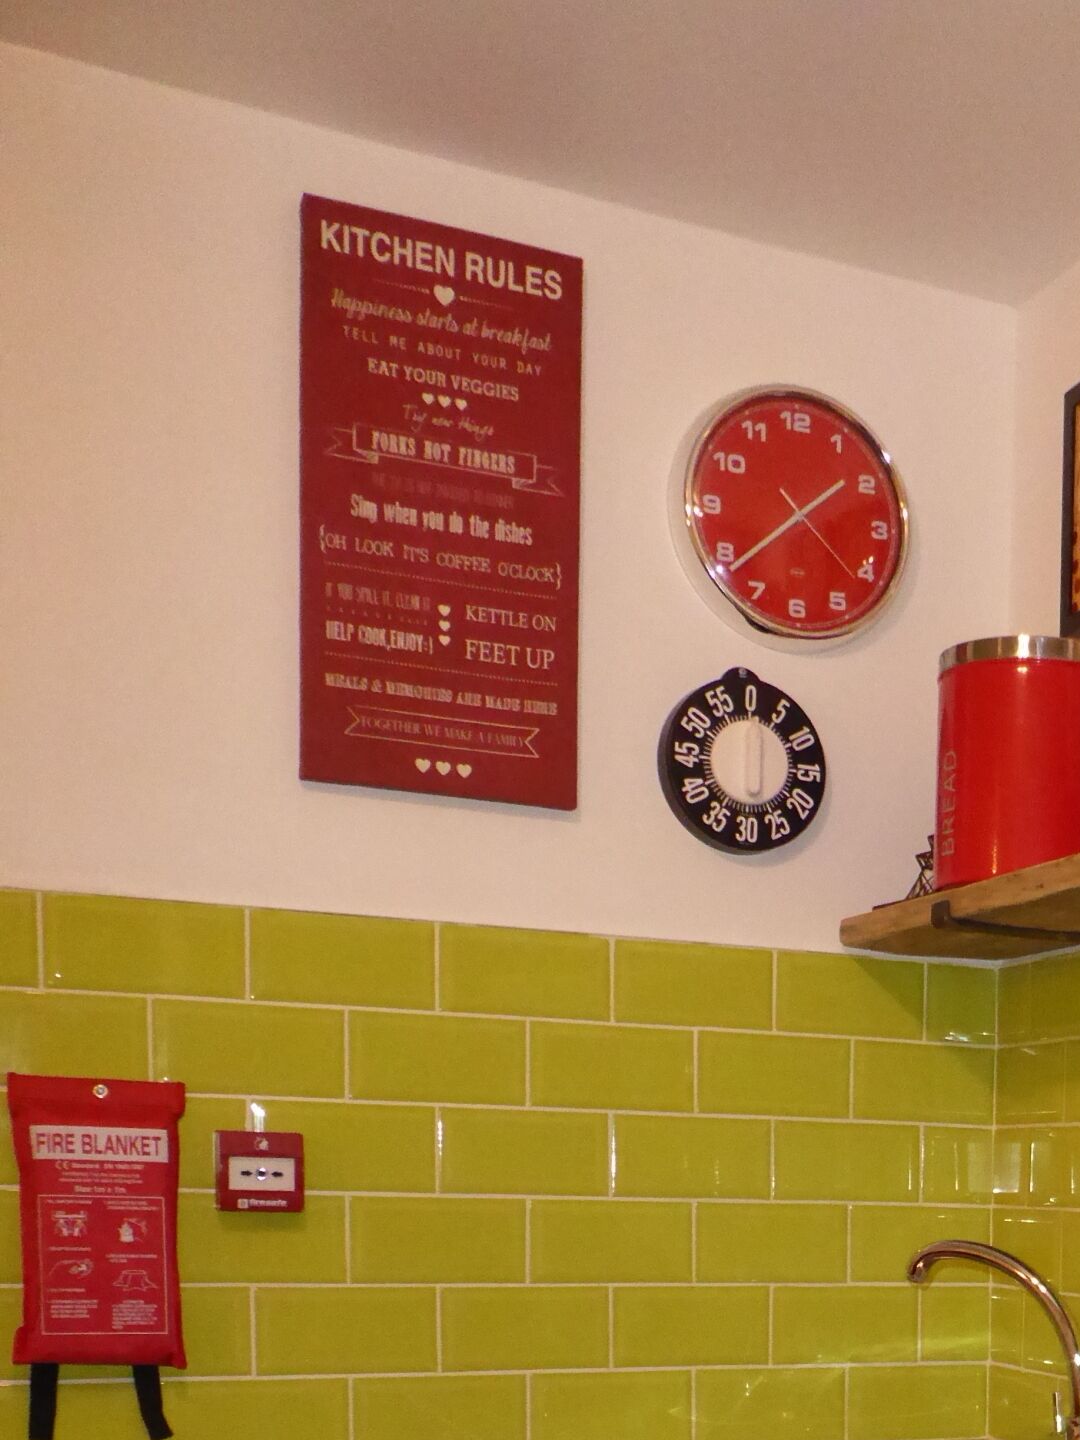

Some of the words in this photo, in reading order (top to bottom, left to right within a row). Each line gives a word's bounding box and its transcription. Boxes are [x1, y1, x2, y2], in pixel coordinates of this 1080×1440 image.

[319, 219, 455, 277] KITCHEN
[464, 251, 563, 300] RULES
[330, 287, 412, 324] Happiness
[416, 308, 459, 333] starts
[463, 317, 479, 336] at
[480, 321, 552, 354] breakfast
[342, 324, 378, 345] TELL
[389, 335, 407, 350] ME
[417, 342, 462, 360] ABOUT
[472, 352, 508, 370] YOUR
[516, 360, 543, 376] DAY
[367, 357, 399, 378] EAT
[403, 365, 447, 388] YOUR
[450, 375, 520, 402] VEGGIES
[741, 419, 767, 443] 11
[778, 410, 811, 433] 12
[371, 430, 416, 457] FORKS
[424, 440, 451, 465] NOT
[458, 446, 516, 475] FINGERS
[830, 433, 842, 454] 1
[712, 450, 746, 474] 10
[857, 475, 876, 495] 2
[703, 494, 721, 514] 9
[383, 501, 417, 527] when
[422, 510, 444, 532] you
[468, 514, 490, 540] the
[870, 520, 888, 540] 3
[354, 536, 395, 558] LOOK
[436, 551, 492, 574] COFFEE
[716, 542, 734, 562] 8
[856, 563, 875, 583] 4
[747, 580, 765, 600] 7
[829, 591, 847, 611] 5
[464, 604, 529, 630] KETTLE
[532, 613, 557, 633] ON
[787, 599, 806, 619] 6
[464, 638, 521, 666] FEET
[525, 646, 555, 671] UP
[370, 680, 384, 694] &
[705, 686, 735, 715] 55
[744, 684, 757, 713] 0
[680, 706, 713, 738] 50
[771, 698, 790, 725] 5
[787, 725, 815, 752] 10
[674, 741, 701, 768] 45
[796, 763, 821, 783] 15
[681, 777, 709, 806] 40
[786, 788, 815, 819] 20
[941, 750, 957, 857] BREAD
[701, 801, 731, 833] 35
[735, 815, 759, 844] 30
[764, 812, 791, 841] 25
[35, 1132, 76, 1154] FIRE
[81, 1133, 162, 1157] BLANKET
